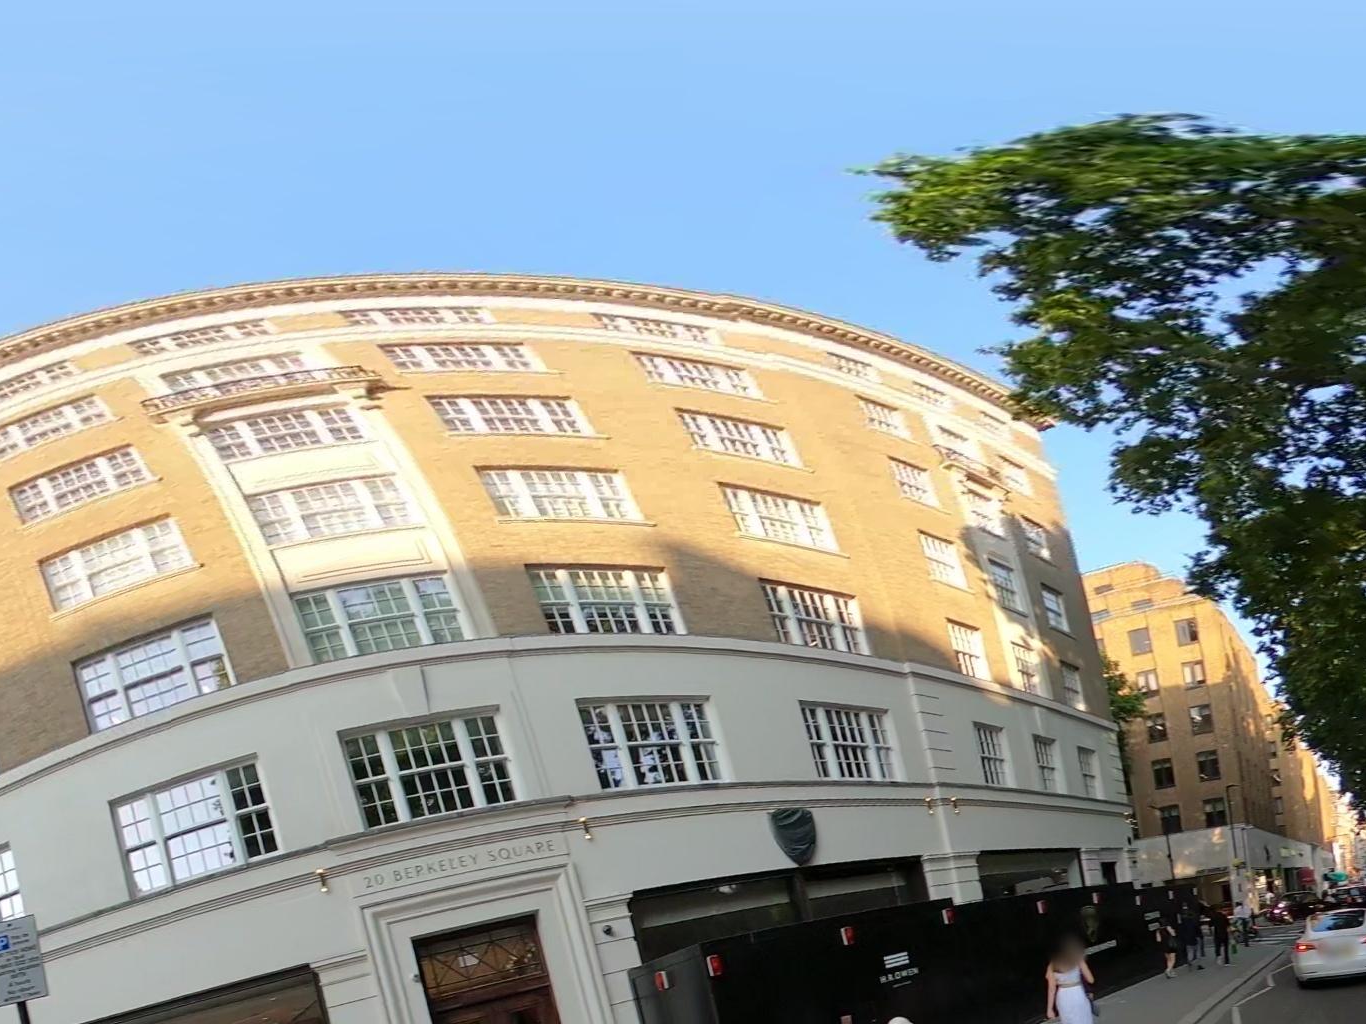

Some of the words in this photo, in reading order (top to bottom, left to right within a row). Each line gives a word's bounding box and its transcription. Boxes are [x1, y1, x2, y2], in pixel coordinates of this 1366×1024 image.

[362, 875, 385, 889] 20
[392, 852, 479, 882] BERKELEY
[487, 839, 556, 862] SQUARE
